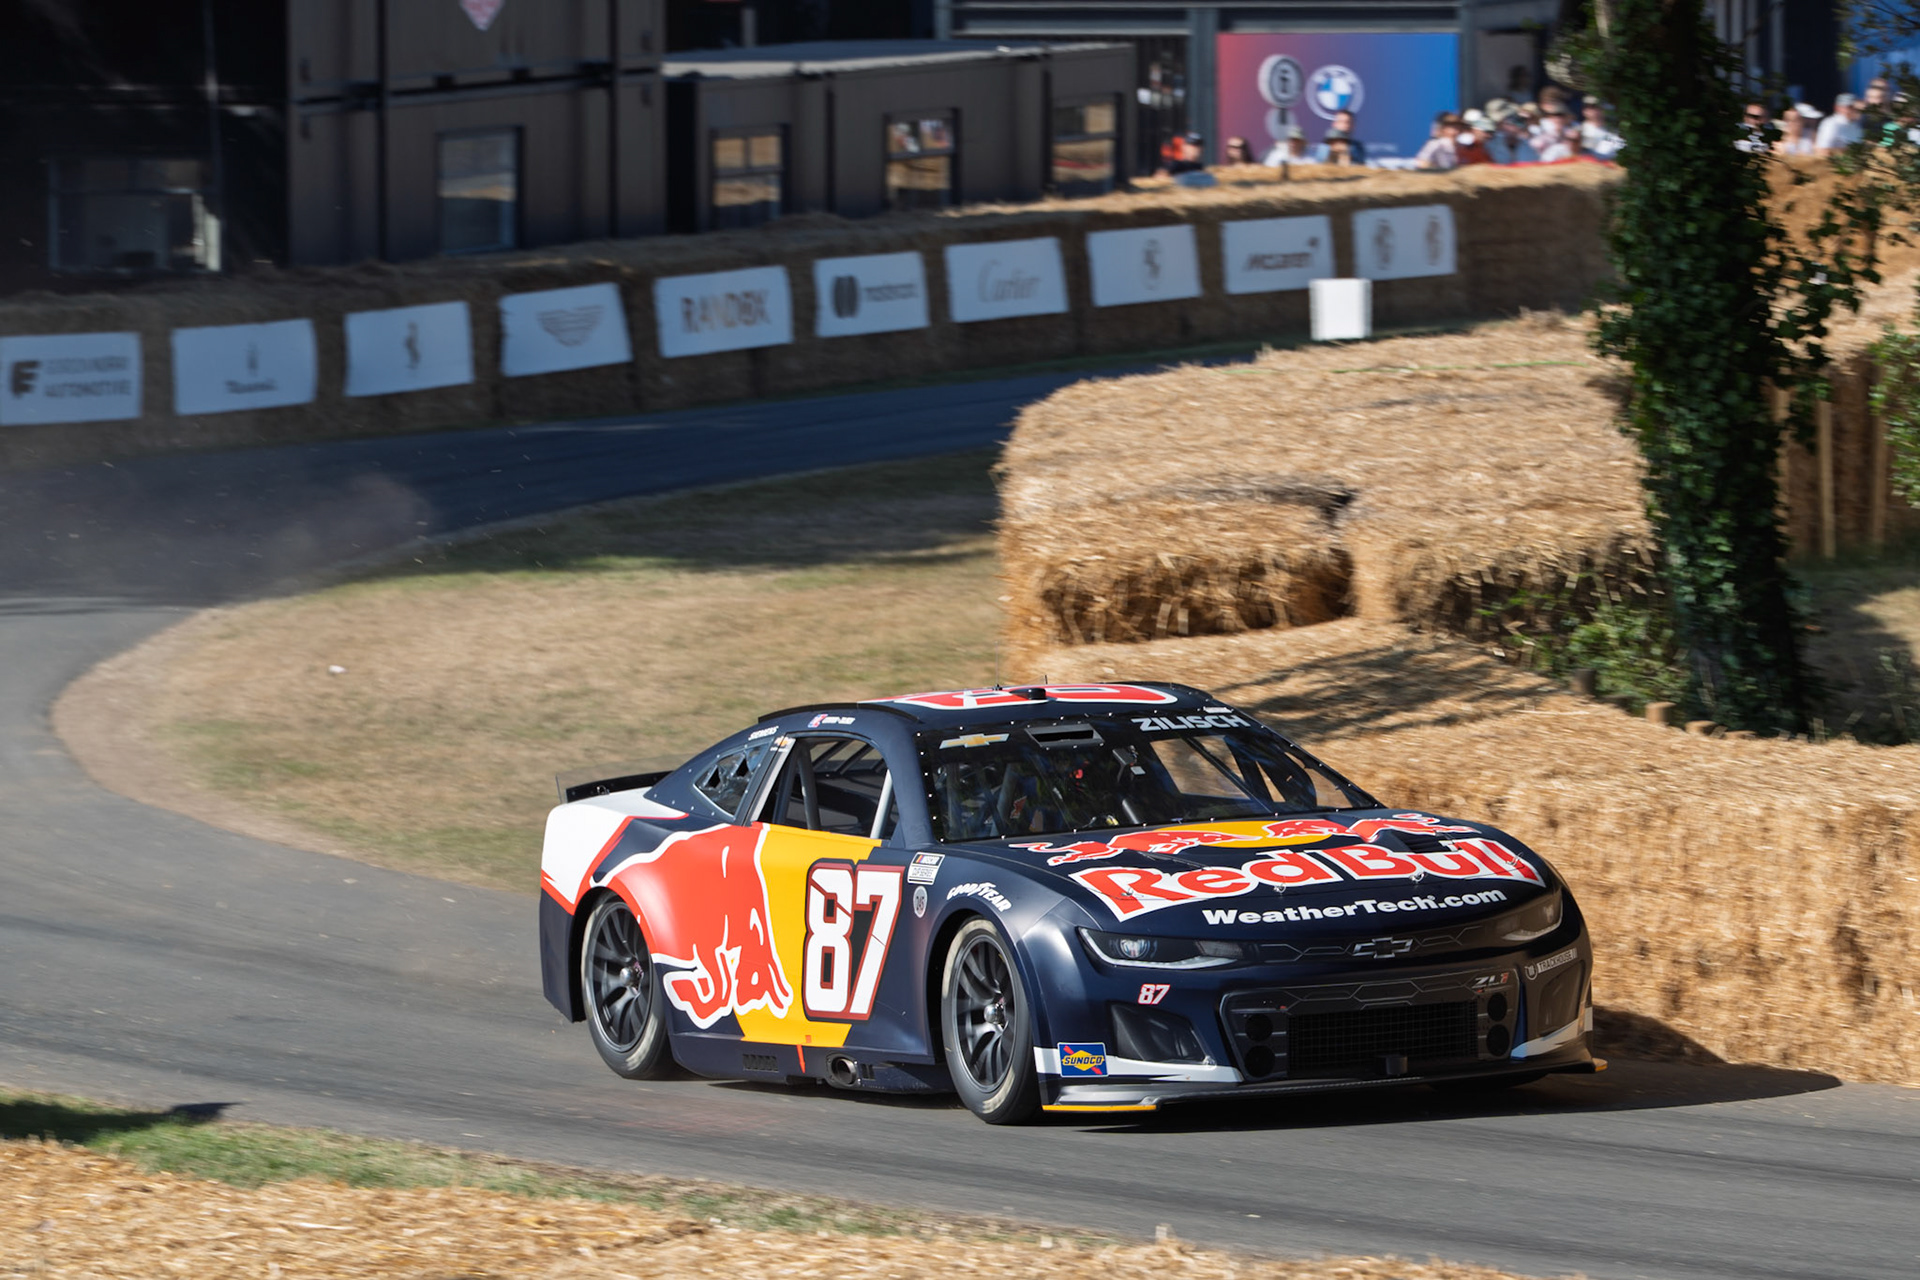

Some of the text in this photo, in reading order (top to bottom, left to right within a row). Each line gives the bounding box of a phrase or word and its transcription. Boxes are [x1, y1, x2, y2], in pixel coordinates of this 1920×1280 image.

[1131, 715, 1251, 731] ZILISCH
[1068, 837, 1546, 922] Red Bull
[946, 882, 1012, 912] GOODYEAR
[803, 861, 906, 1021] 87
[1138, 983, 1171, 1005] 87
[1064, 1056, 1104, 1065] SUNOCO
